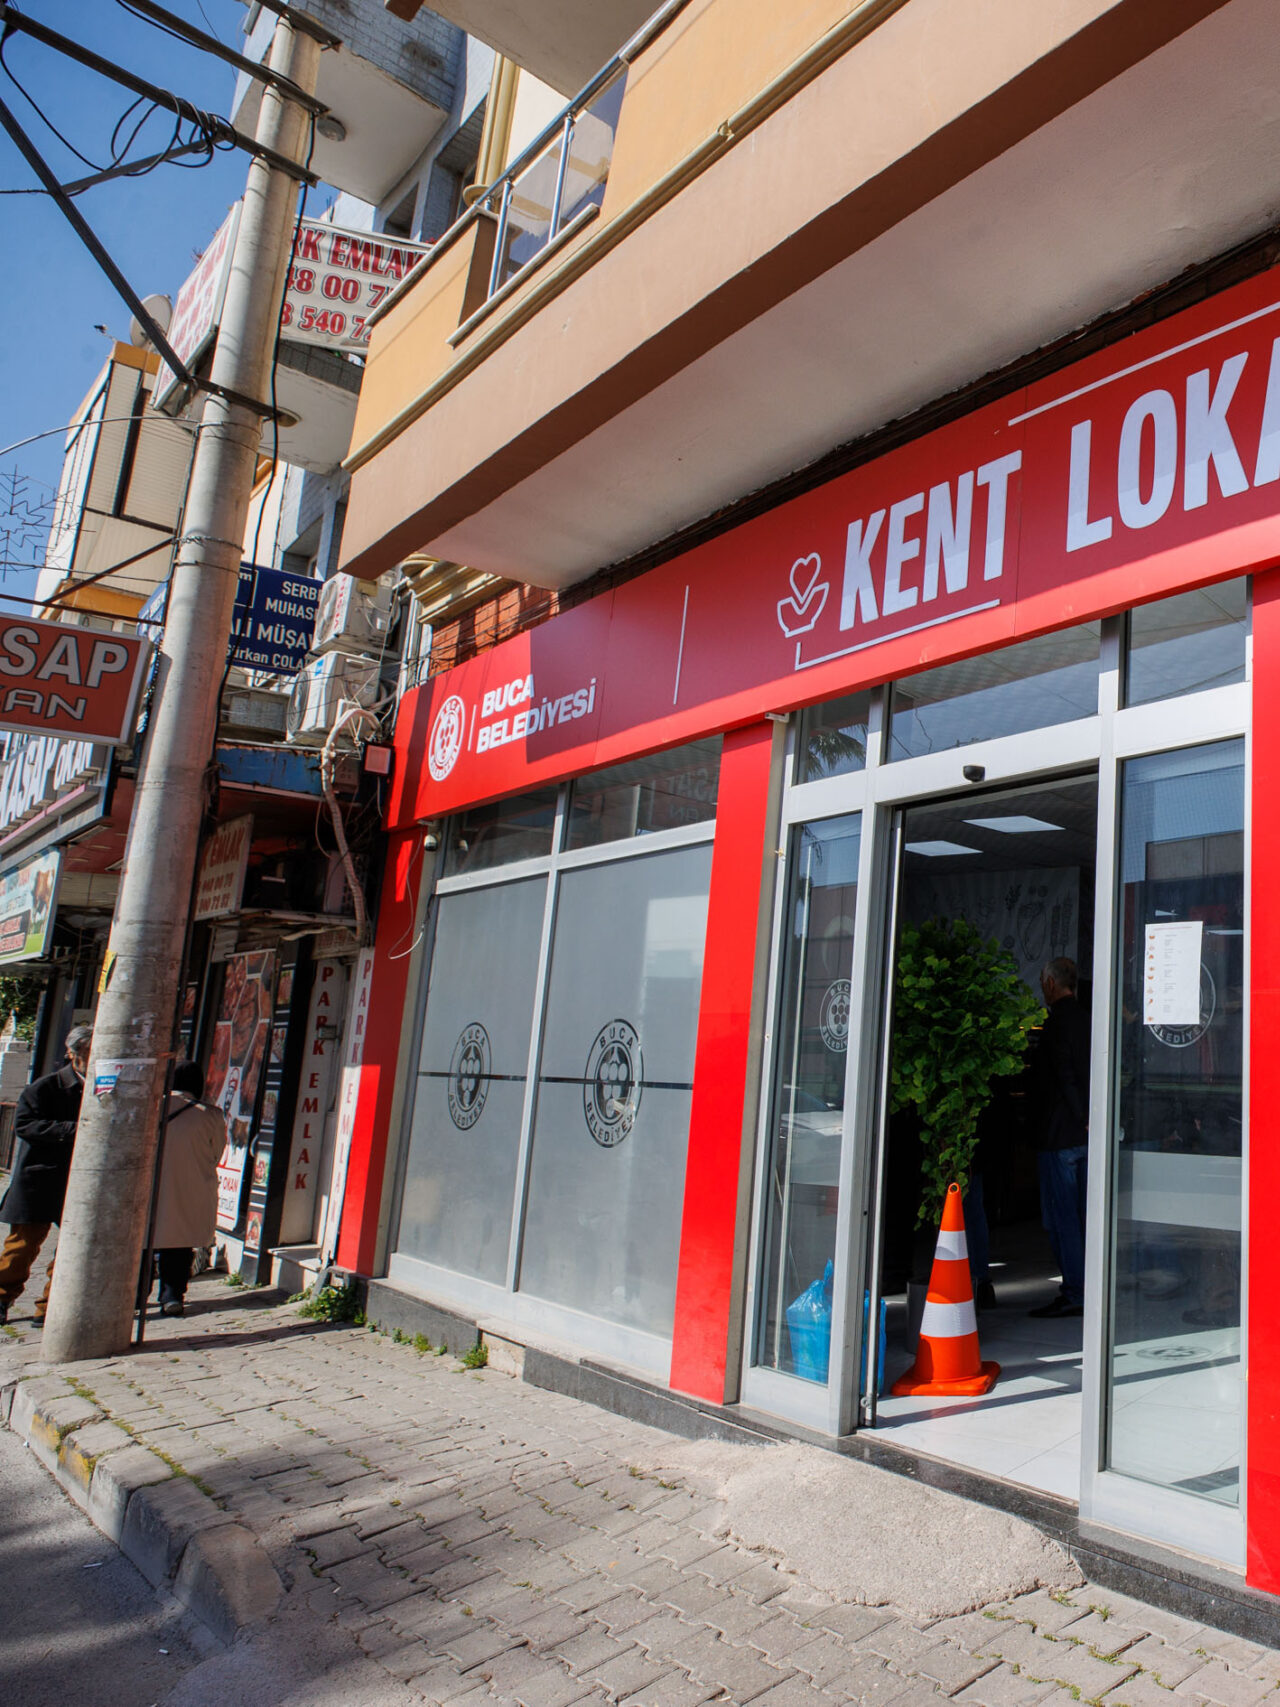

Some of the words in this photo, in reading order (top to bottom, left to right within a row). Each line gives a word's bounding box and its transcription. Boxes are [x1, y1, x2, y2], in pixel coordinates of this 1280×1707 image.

[322, 273, 361, 303] 00
[367, 281, 394, 308] 7
[299, 305, 346, 336] 540
[839, 449, 1022, 632] KENT
[0, 626, 129, 689] SAP
[272, 653, 304, 671] ÇOLA
[2, 687, 87, 721] AN
[476, 677, 597, 754] BELEDİYESİ
[481, 674, 535, 718] BUCA
[0, 736, 60, 831] KASAP
[53, 739, 94, 791] OKAN
[312, 966, 335, 1056] PARK
[351, 959, 372, 1065] PARK
[461, 1028, 485, 1048] BUCA
[600, 1027, 634, 1048] BUCA
[294, 1072, 320, 1190] EMLAK
[586, 1101, 634, 1143] BELEDİYE
